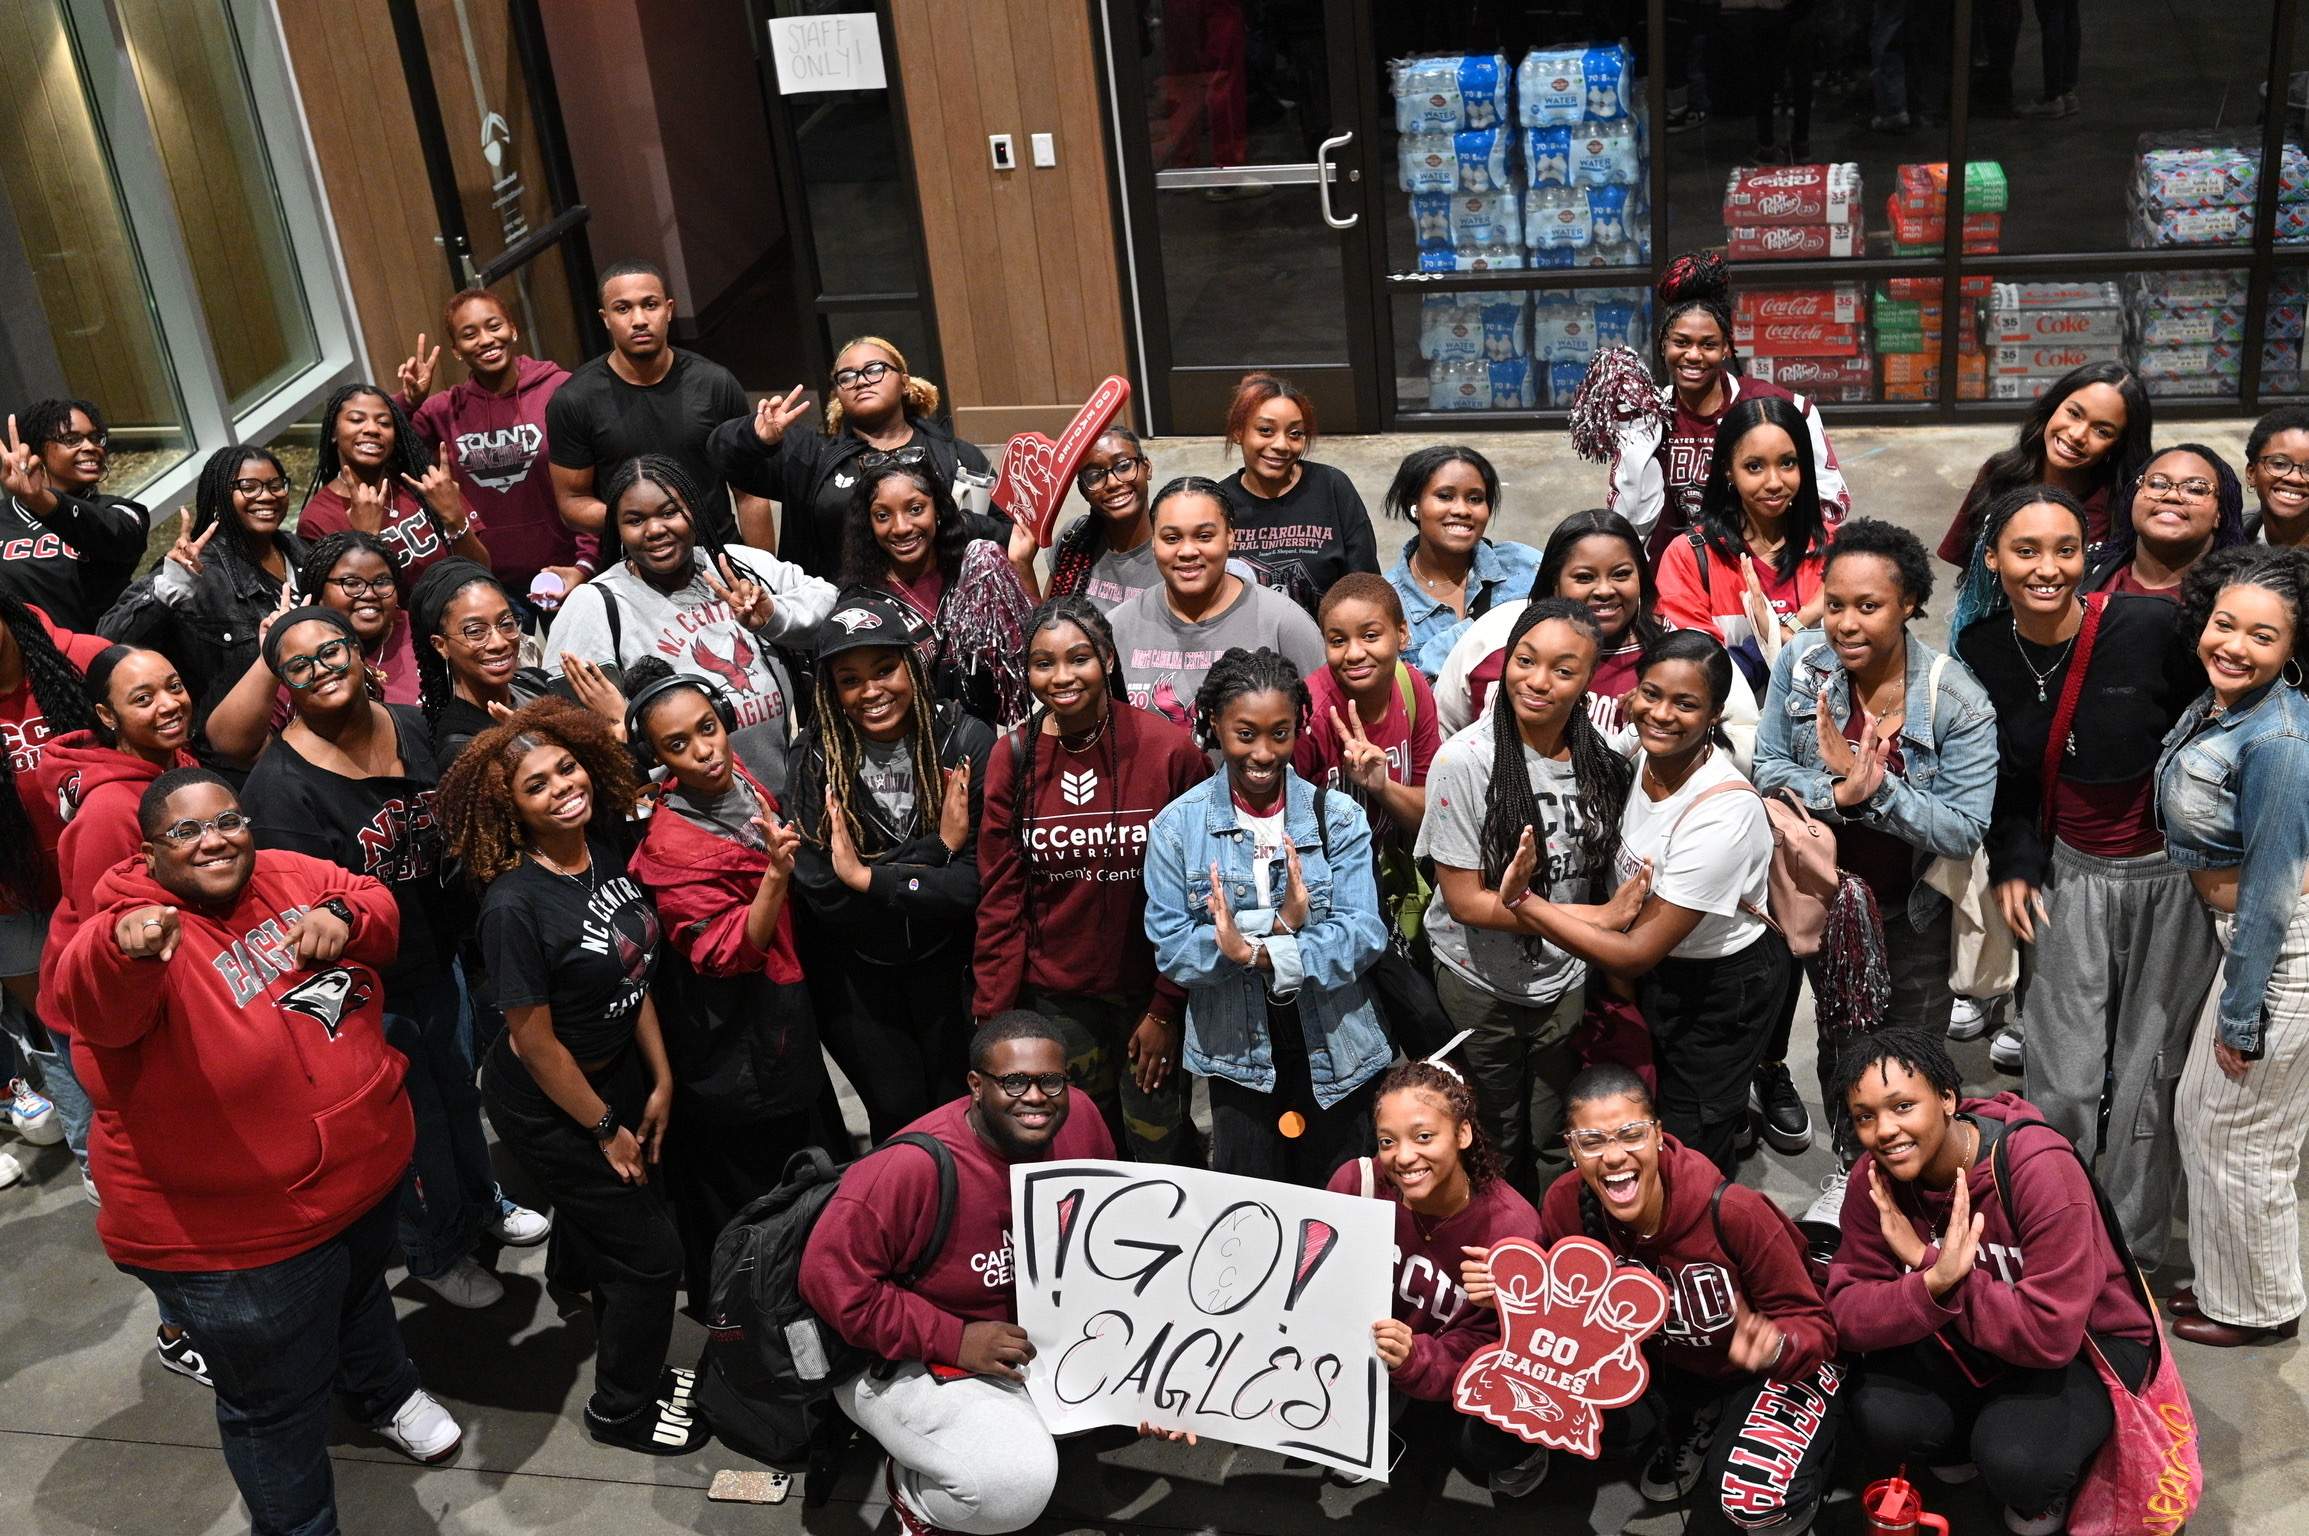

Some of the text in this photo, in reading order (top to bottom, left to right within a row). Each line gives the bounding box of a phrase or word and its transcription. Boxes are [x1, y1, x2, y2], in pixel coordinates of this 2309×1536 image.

[788, 20, 847, 54] STAFF
[792, 39, 862, 79] ONLY!
[1545, 96, 1577, 104] WATER
[1424, 111, 1456, 119] WATER
[1580, 158, 1611, 167] WATER
[1831, 191, 1847, 200] 35
[1761, 198, 1797, 215] Pepper
[1766, 232, 1801, 249] Pepper
[1837, 297, 1852, 306] 35
[2002, 318, 2018, 327] 35
[2036, 315, 2090, 334] Coke
[1558, 340, 1588, 348] WATER
[2001, 351, 2016, 359] 35
[2034, 350, 2088, 367] Coke
[1755, 363, 1770, 371] 35
[1781, 366, 1816, 382] Pepper
[2001, 384, 2016, 392] 35
[1095, 390, 1111, 409] GO
[456, 423, 543, 462] SOUND
[1258, 524, 1333, 540] CAROLINA
[1262, 538, 1324, 549] UNIVERSITY
[675, 600, 737, 634] CENT
[1151, 649, 1183, 669] CAROLINA
[733, 691, 783, 731] AGLES
[1032, 846, 1140, 862] NIVERSIT
[580, 877, 643, 956] NC CENTR
[1528, 1328, 1579, 1367] GO
[1054, 1309, 1343, 1431] EAGLES
[1501, 1352, 1587, 1396] EAGLES
